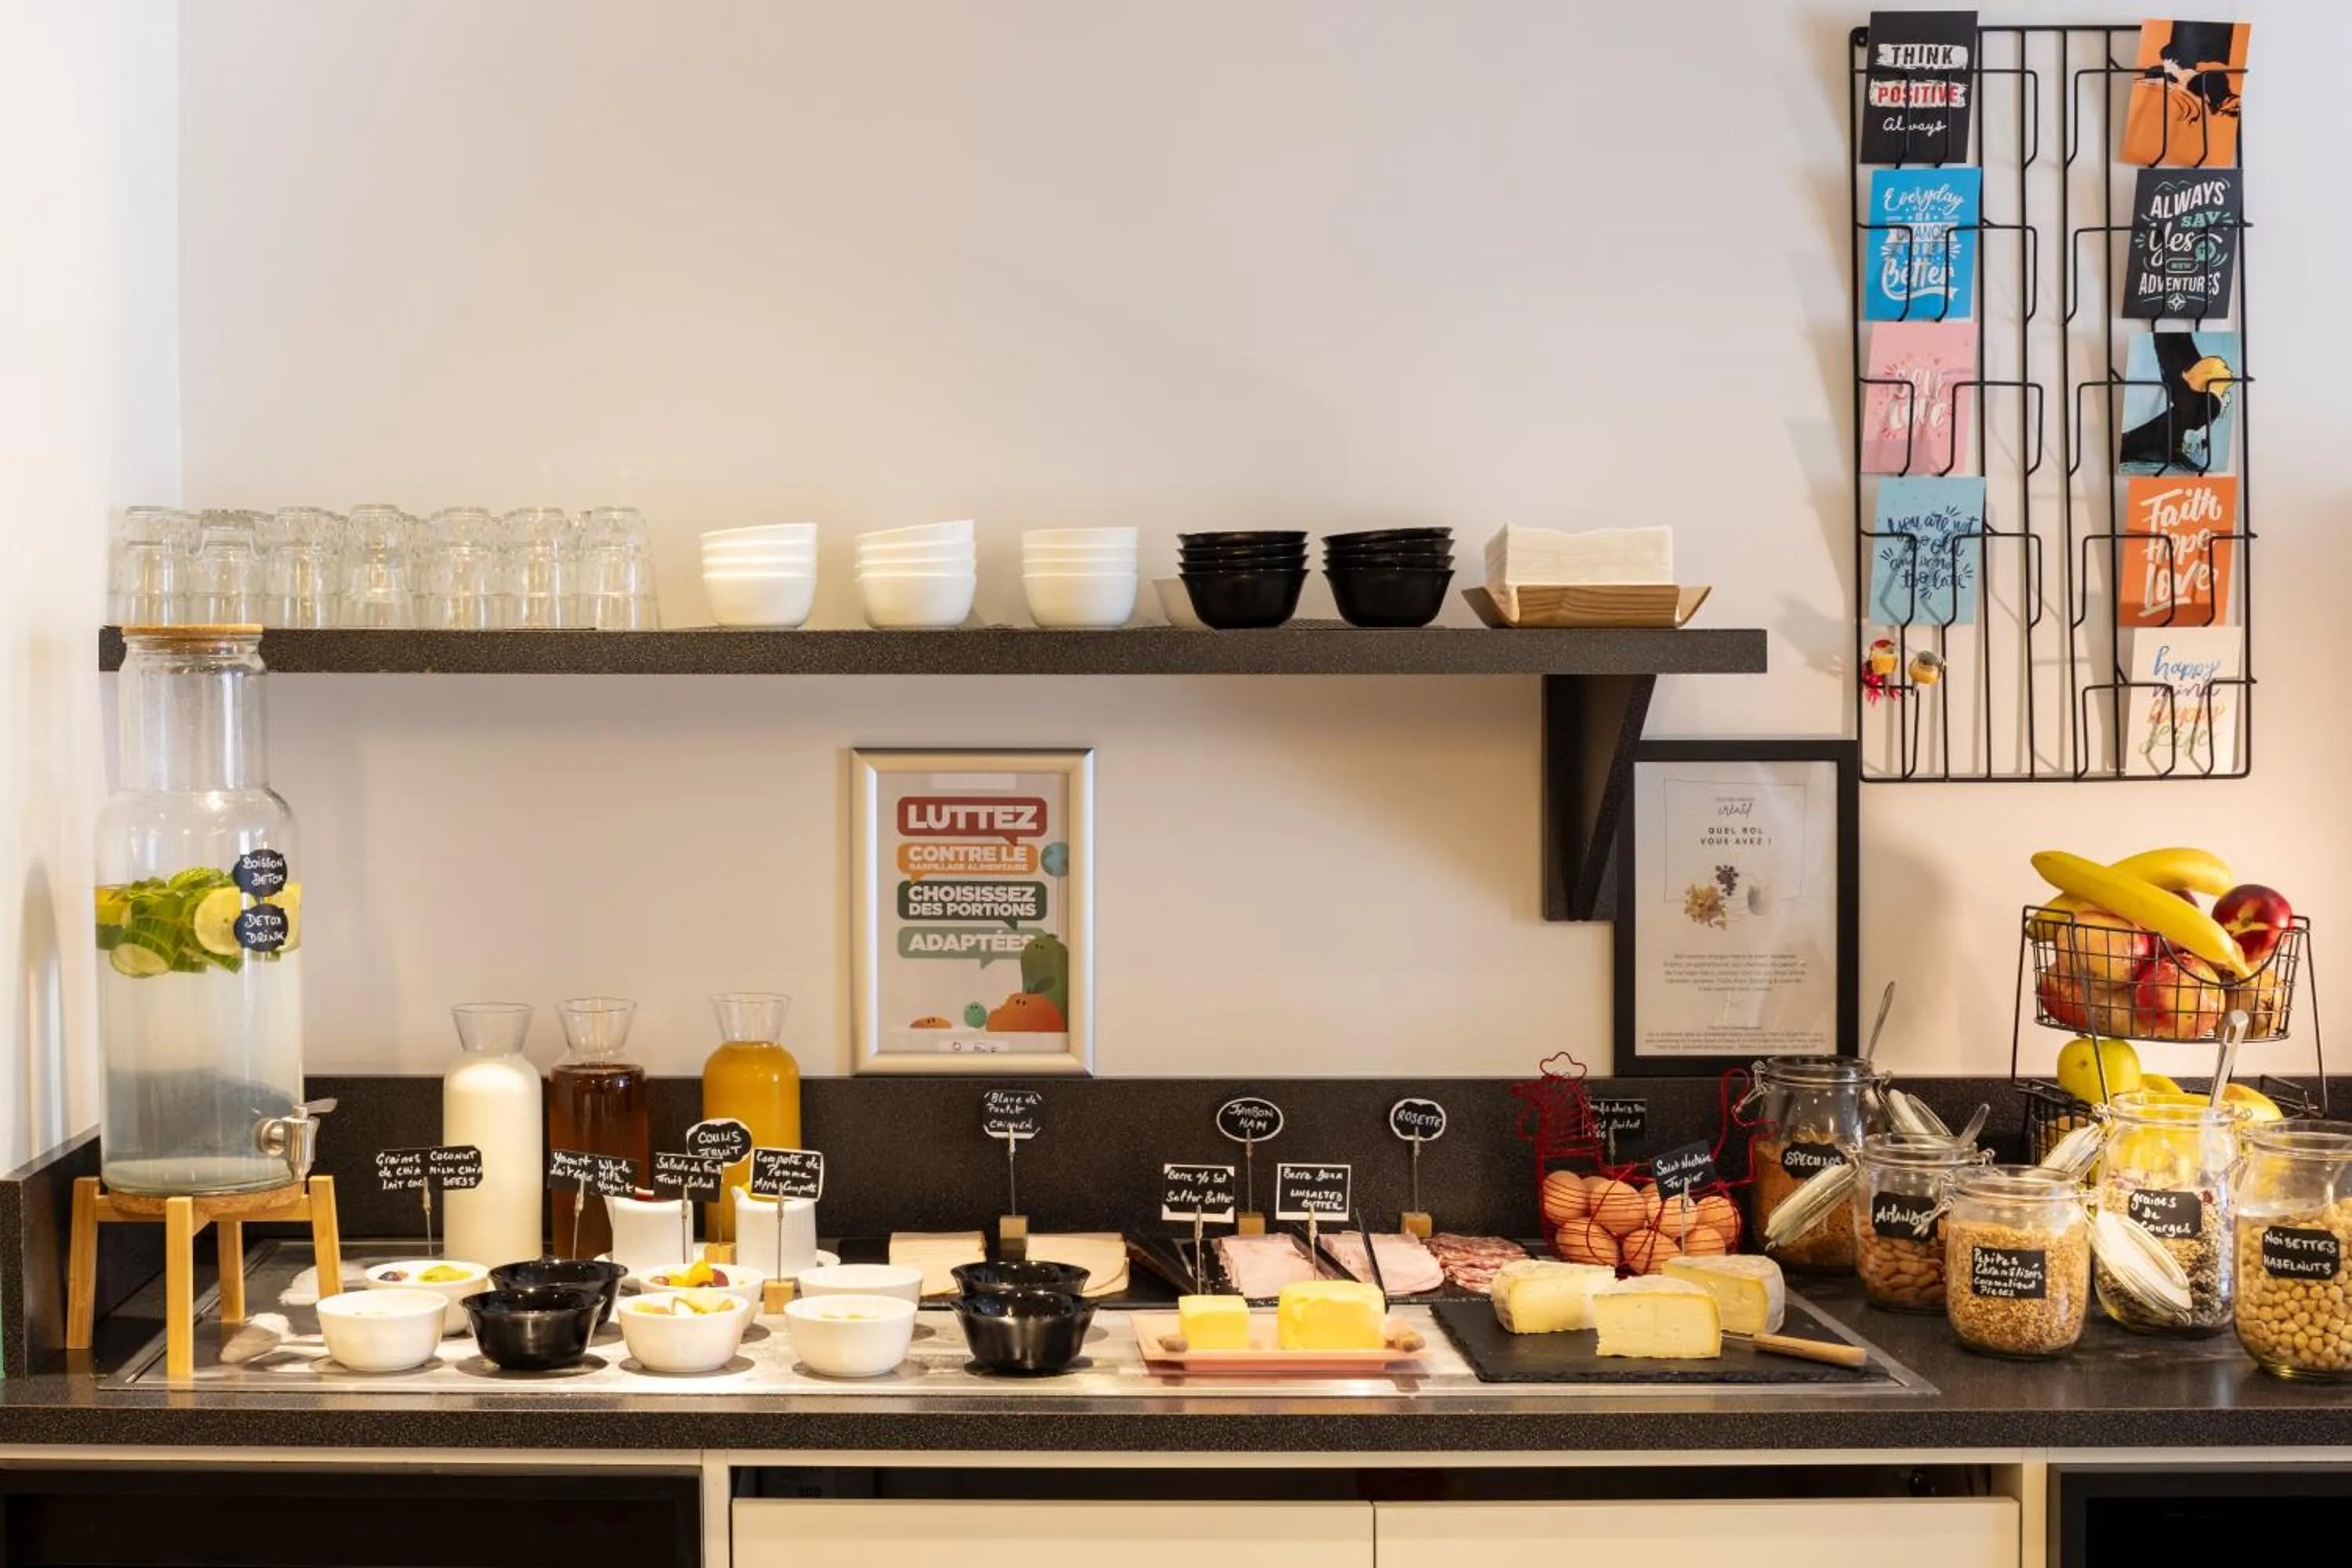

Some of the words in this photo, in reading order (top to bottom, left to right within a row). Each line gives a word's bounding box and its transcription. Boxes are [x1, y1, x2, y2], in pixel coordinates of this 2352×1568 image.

[1891, 45, 1953, 65] THINK
[1878, 84, 1958, 103] POSITIVE
[1883, 183, 1965, 216] Everyday
[2150, 180, 2226, 219] ALWAYS
[2181, 211, 2221, 228] SAY
[1896, 224, 1947, 240] CANCE
[1882, 257, 1958, 298] Better
[2140, 487, 2223, 535] Faith
[2153, 645, 2221, 684] happy
[908, 804, 1038, 830] LUTTEZ
[909, 845, 997, 862] CONTRE
[1001, 845, 1028, 862] LE
[908, 885, 1036, 902] CHOISISSEZ
[909, 902, 943, 916] DES
[946, 902, 1037, 916] PORTIONS
